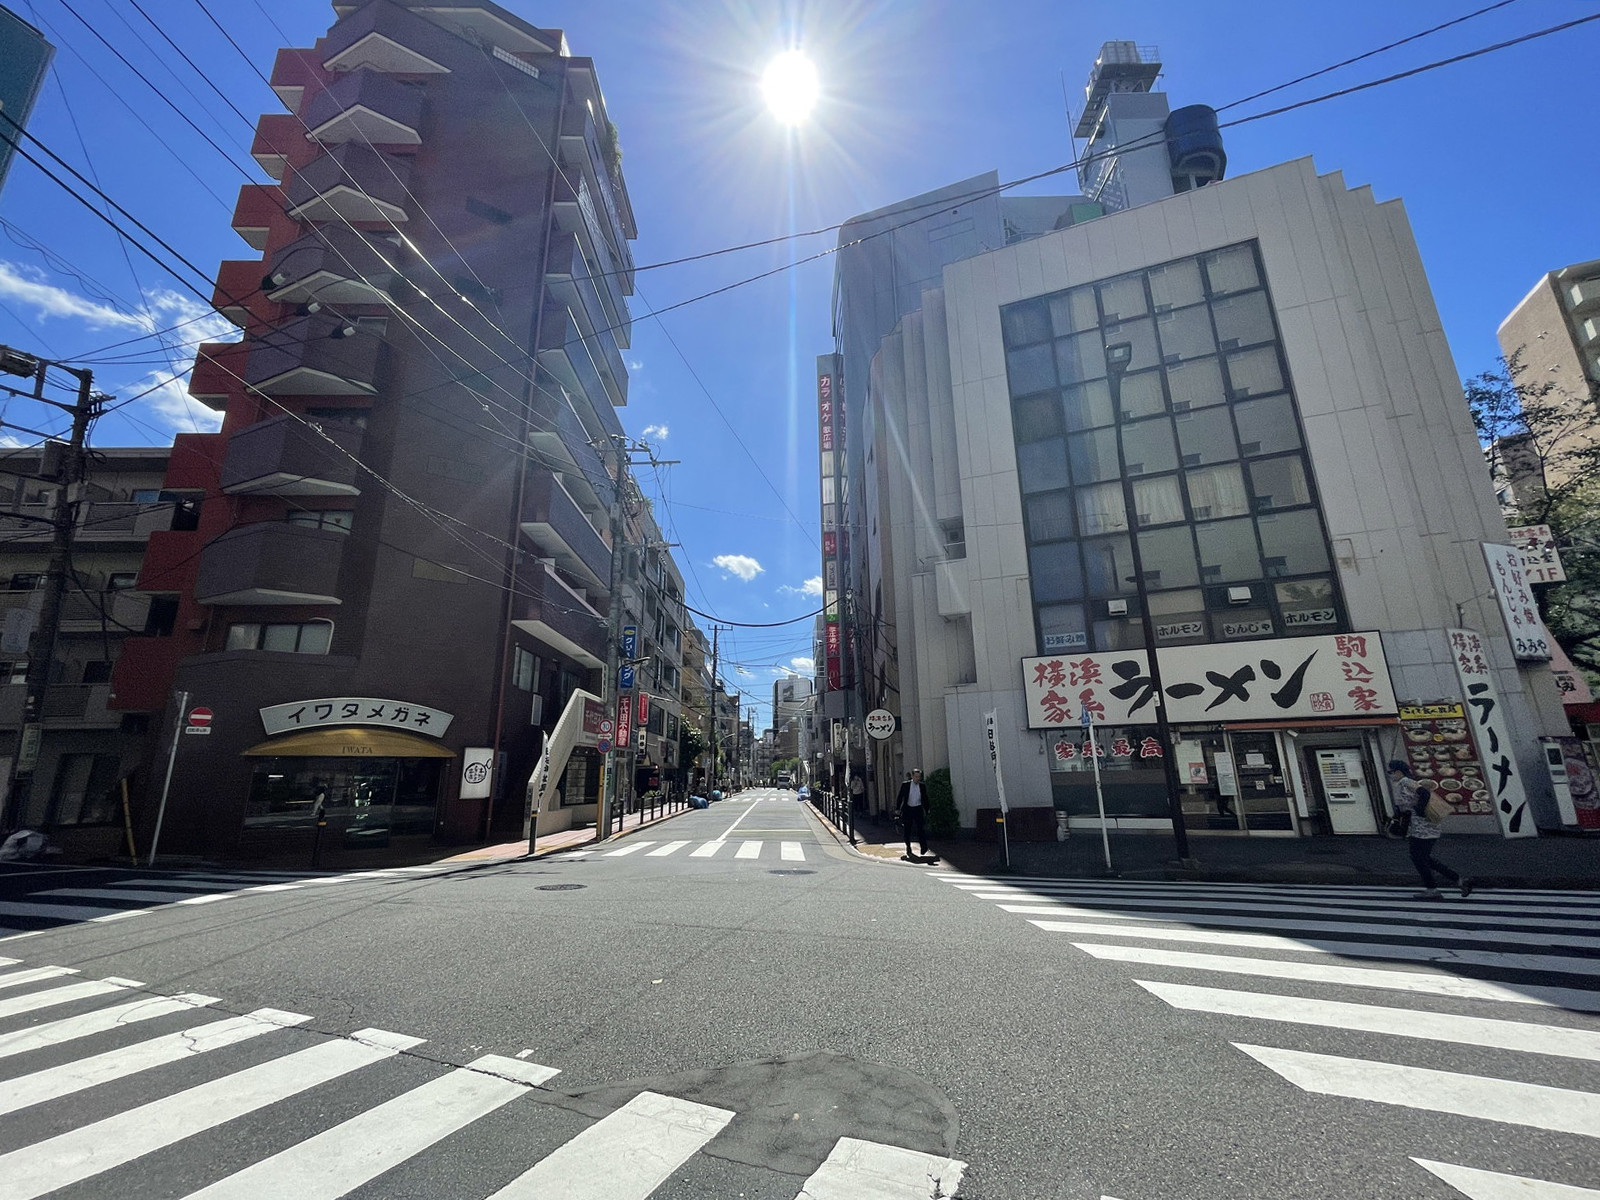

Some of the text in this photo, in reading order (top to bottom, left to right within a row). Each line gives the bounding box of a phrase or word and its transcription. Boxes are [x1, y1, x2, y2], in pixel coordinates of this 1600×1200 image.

[1536, 567, 1558, 581] 1F
[1496, 559, 1522, 630] もんじゃ
[1506, 550, 1537, 625] お好み焼
[1224, 622, 1271, 634] もんじゃ
[1286, 610, 1334, 624] ホルモン
[1158, 624, 1202, 636] ホルモン
[1451, 632, 1482, 653] 横浜
[1516, 637, 1548, 654] みみや
[1033, 657, 1103, 689] 横浜
[1334, 635, 1382, 711] 駒込家
[1458, 652, 1488, 675] 家系
[1109, 649, 1319, 718] ラーメン
[288, 703, 432, 727] イワタメガネ
[1041, 688, 1105, 723] 家系
[618, 697, 629, 747] 千代田不動産
[868, 722, 894, 733] ラーメン
[341, 745, 373, 755] IWATA
[1054, 736, 1165, 760] 家系最高
[1467, 683, 1527, 833] ラーメン
